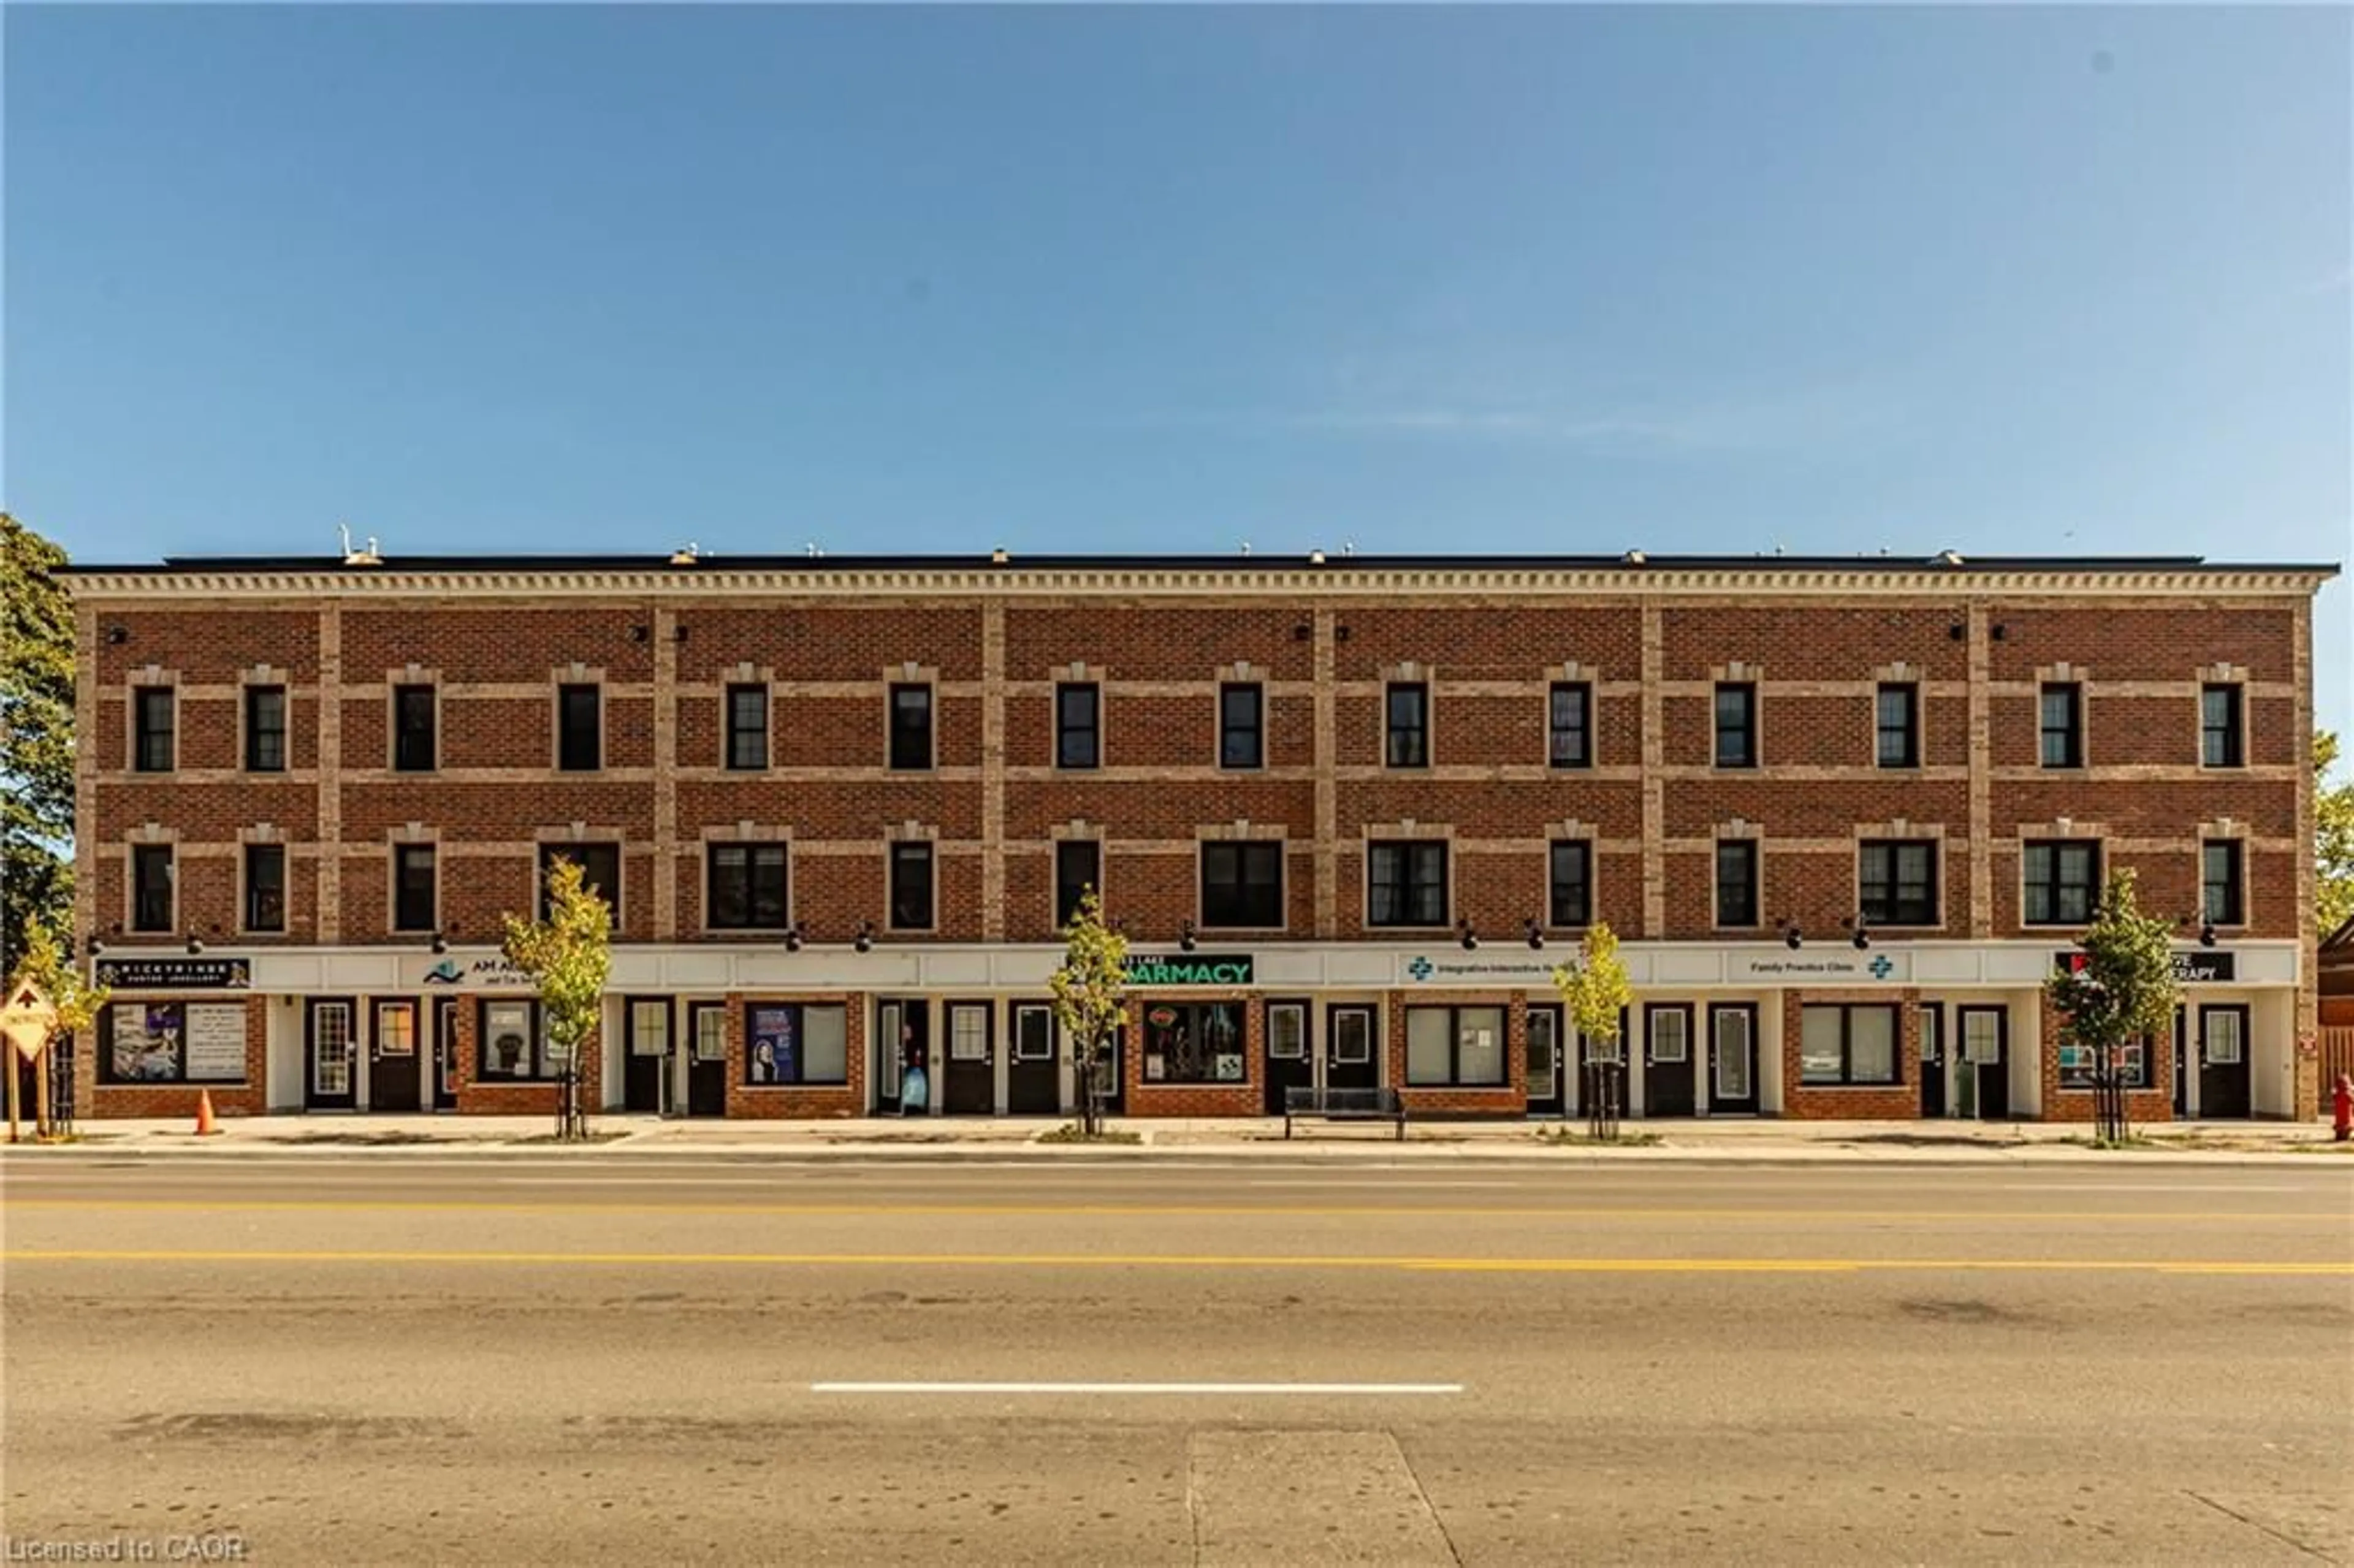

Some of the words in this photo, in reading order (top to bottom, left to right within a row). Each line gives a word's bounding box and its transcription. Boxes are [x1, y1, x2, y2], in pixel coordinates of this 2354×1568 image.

[472, 961, 496, 973] AM
[1751, 962, 1783, 974] Family
[1786, 962, 1824, 972] Practice
[1827, 962, 1854, 973] Clinic
